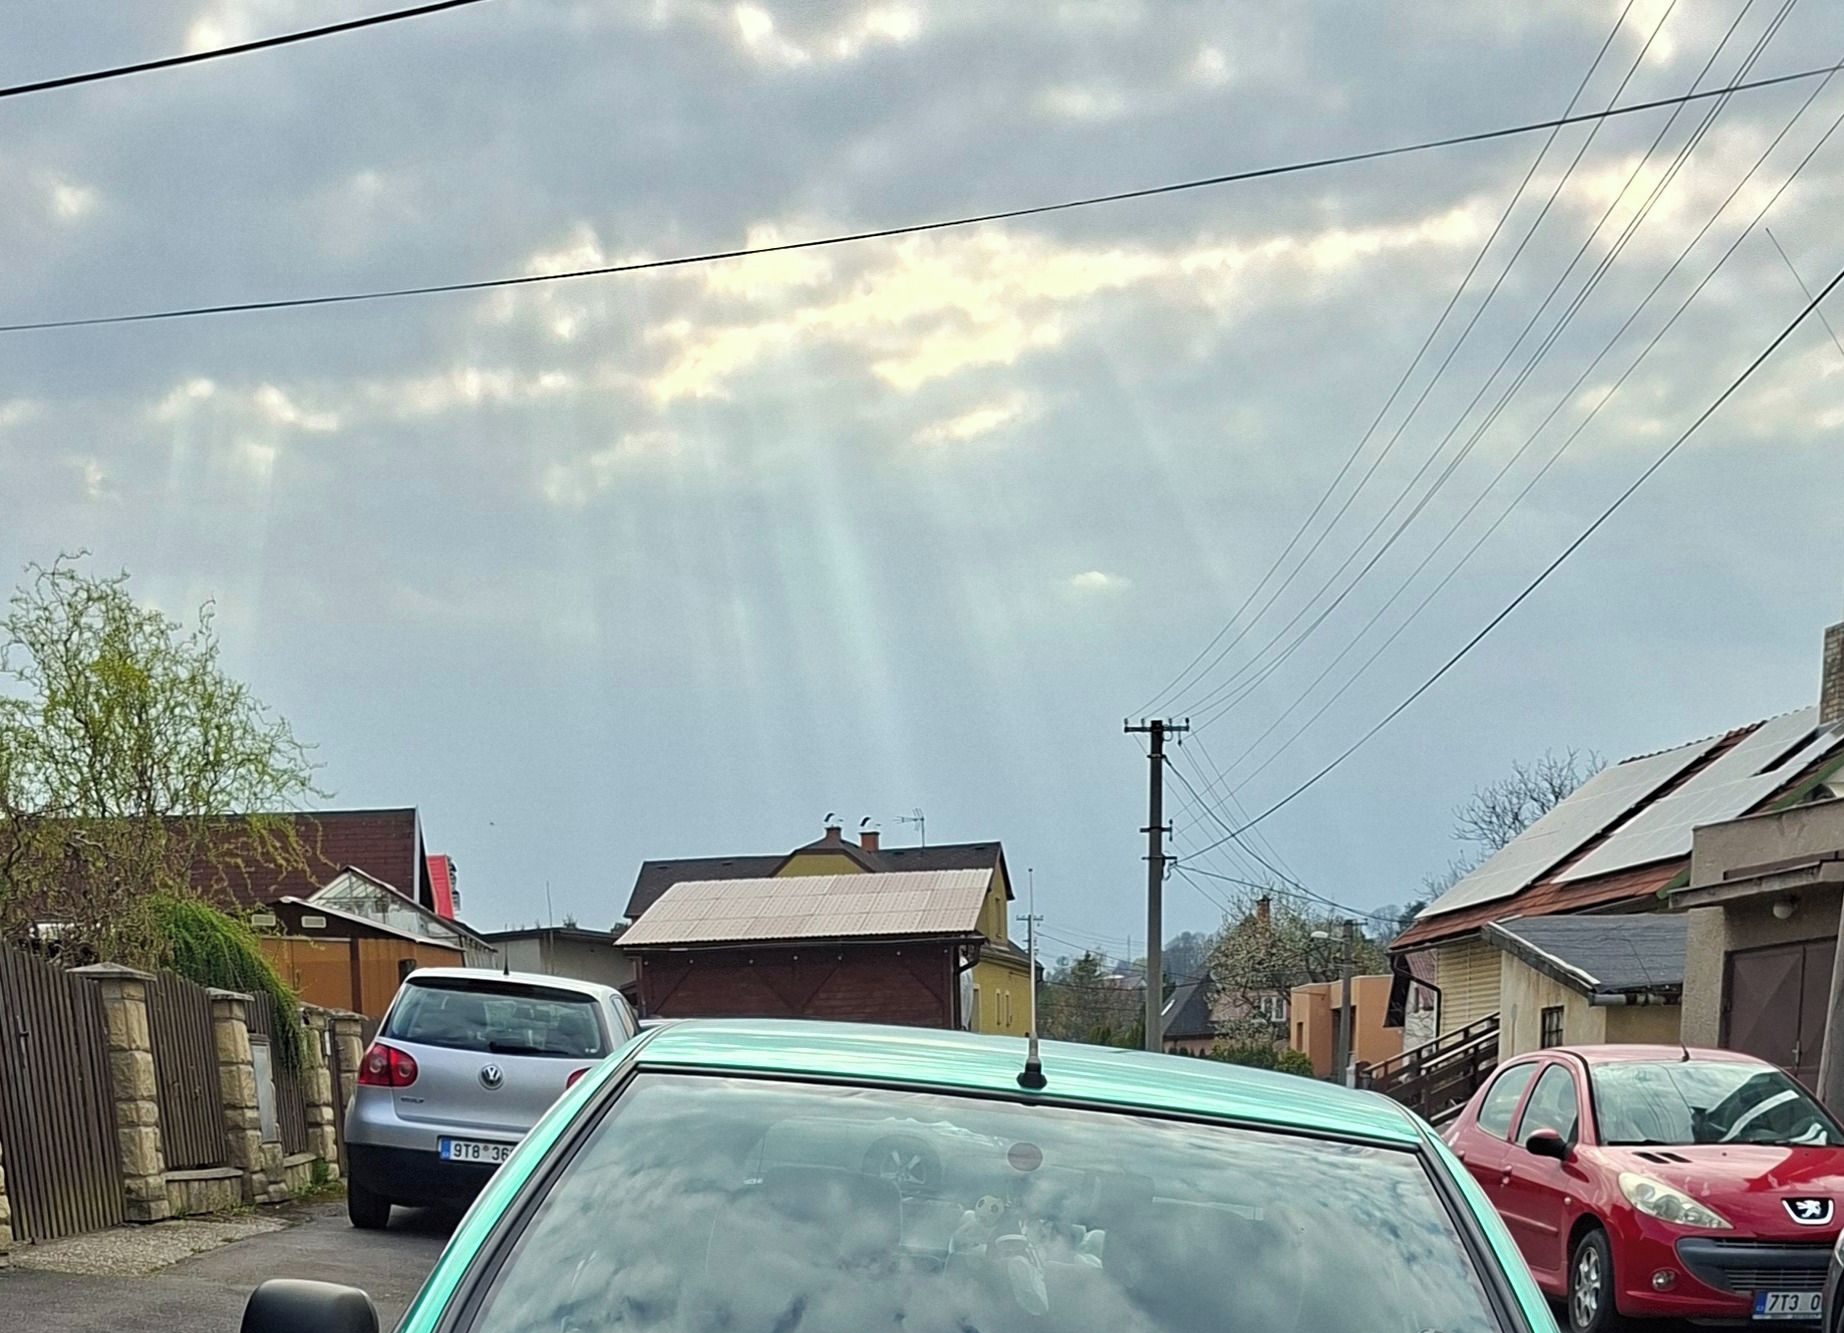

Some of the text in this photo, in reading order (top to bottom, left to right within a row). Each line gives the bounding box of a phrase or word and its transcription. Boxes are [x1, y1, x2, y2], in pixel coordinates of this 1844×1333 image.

[453, 1143, 514, 1161] 9T8 36
[1768, 1294, 1799, 1311] 7T3
